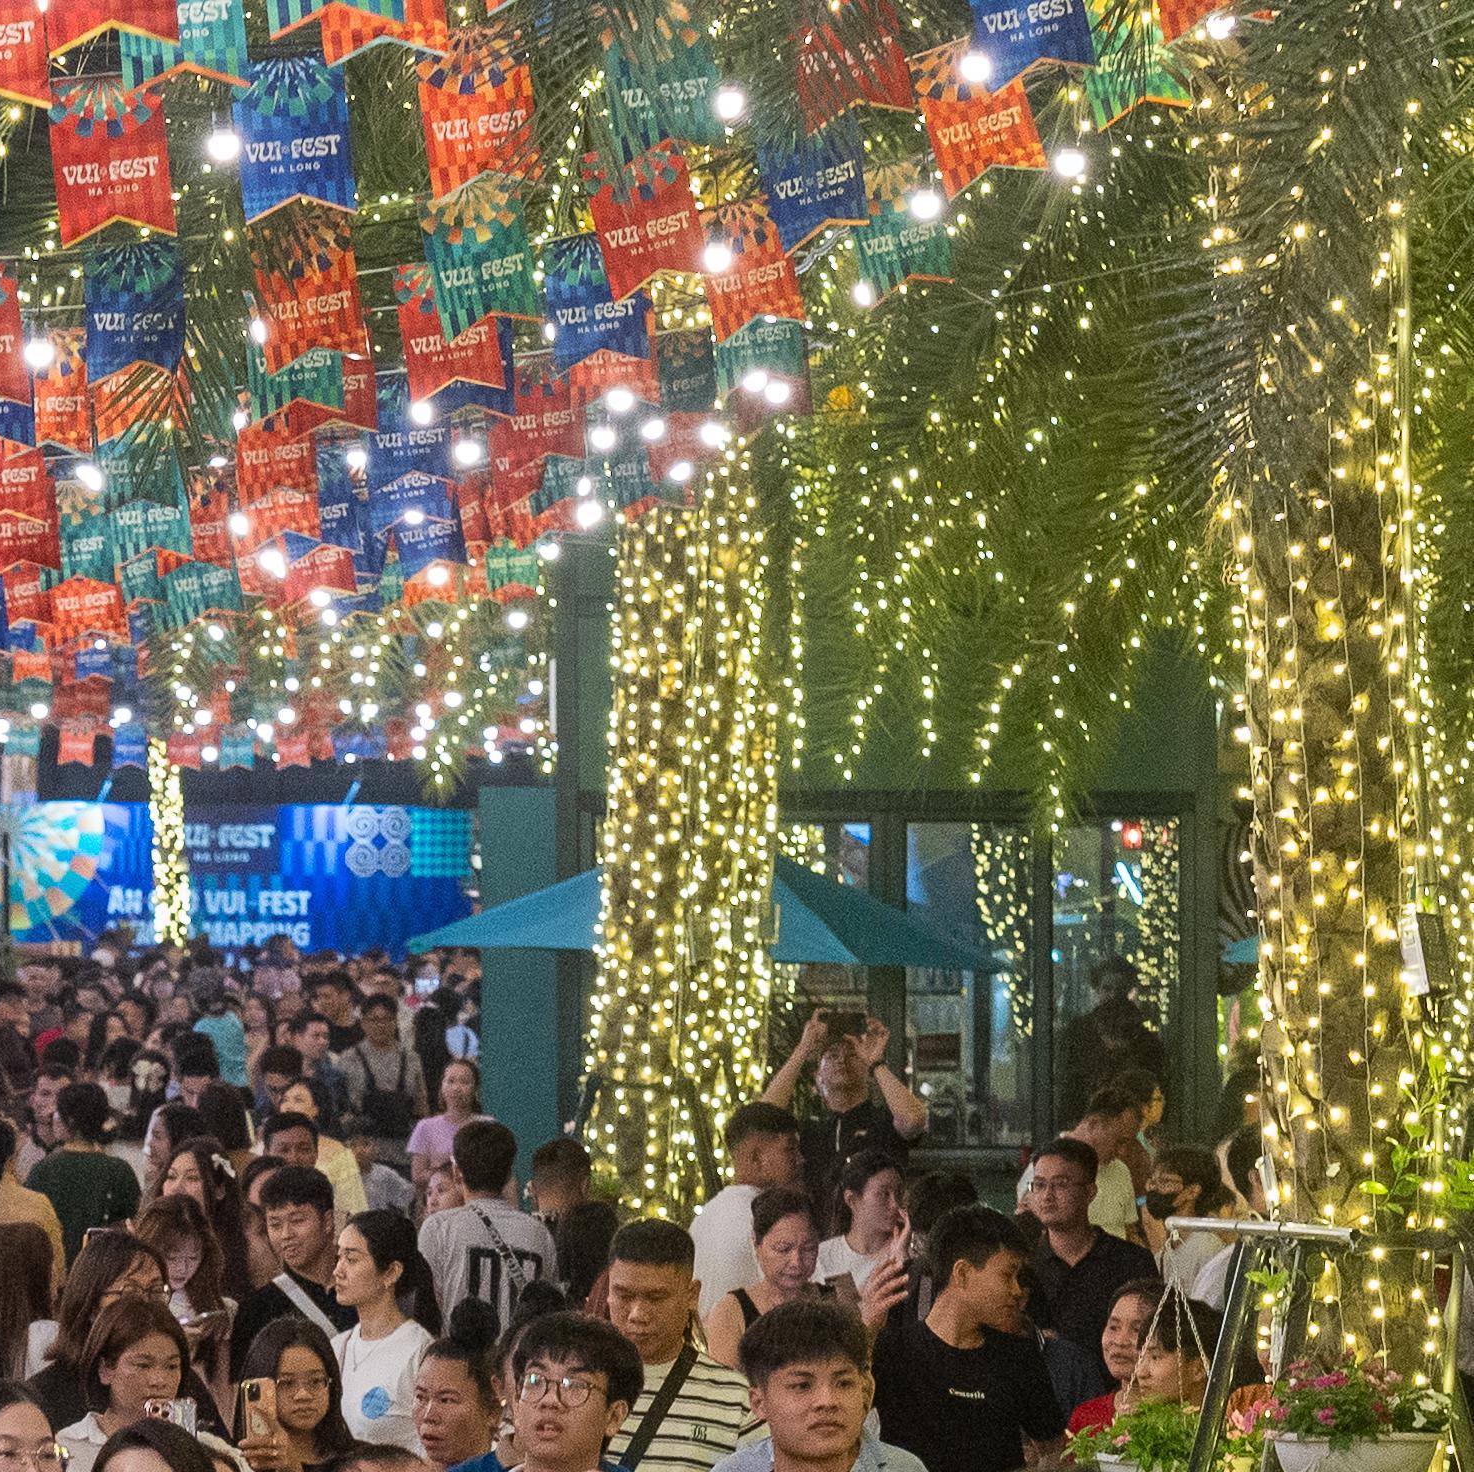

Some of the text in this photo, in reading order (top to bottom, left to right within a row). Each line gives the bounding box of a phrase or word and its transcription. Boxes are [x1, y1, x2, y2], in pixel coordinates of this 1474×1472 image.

[983, 0, 1074, 33] VUI FEST
[245, 135, 340, 163] VUI FEST
[63, 156, 158, 185] VUI FEST
[290, 161, 320, 173] LONG
[108, 183, 139, 194] LONG
[605, 211, 689, 248] VUI FEST
